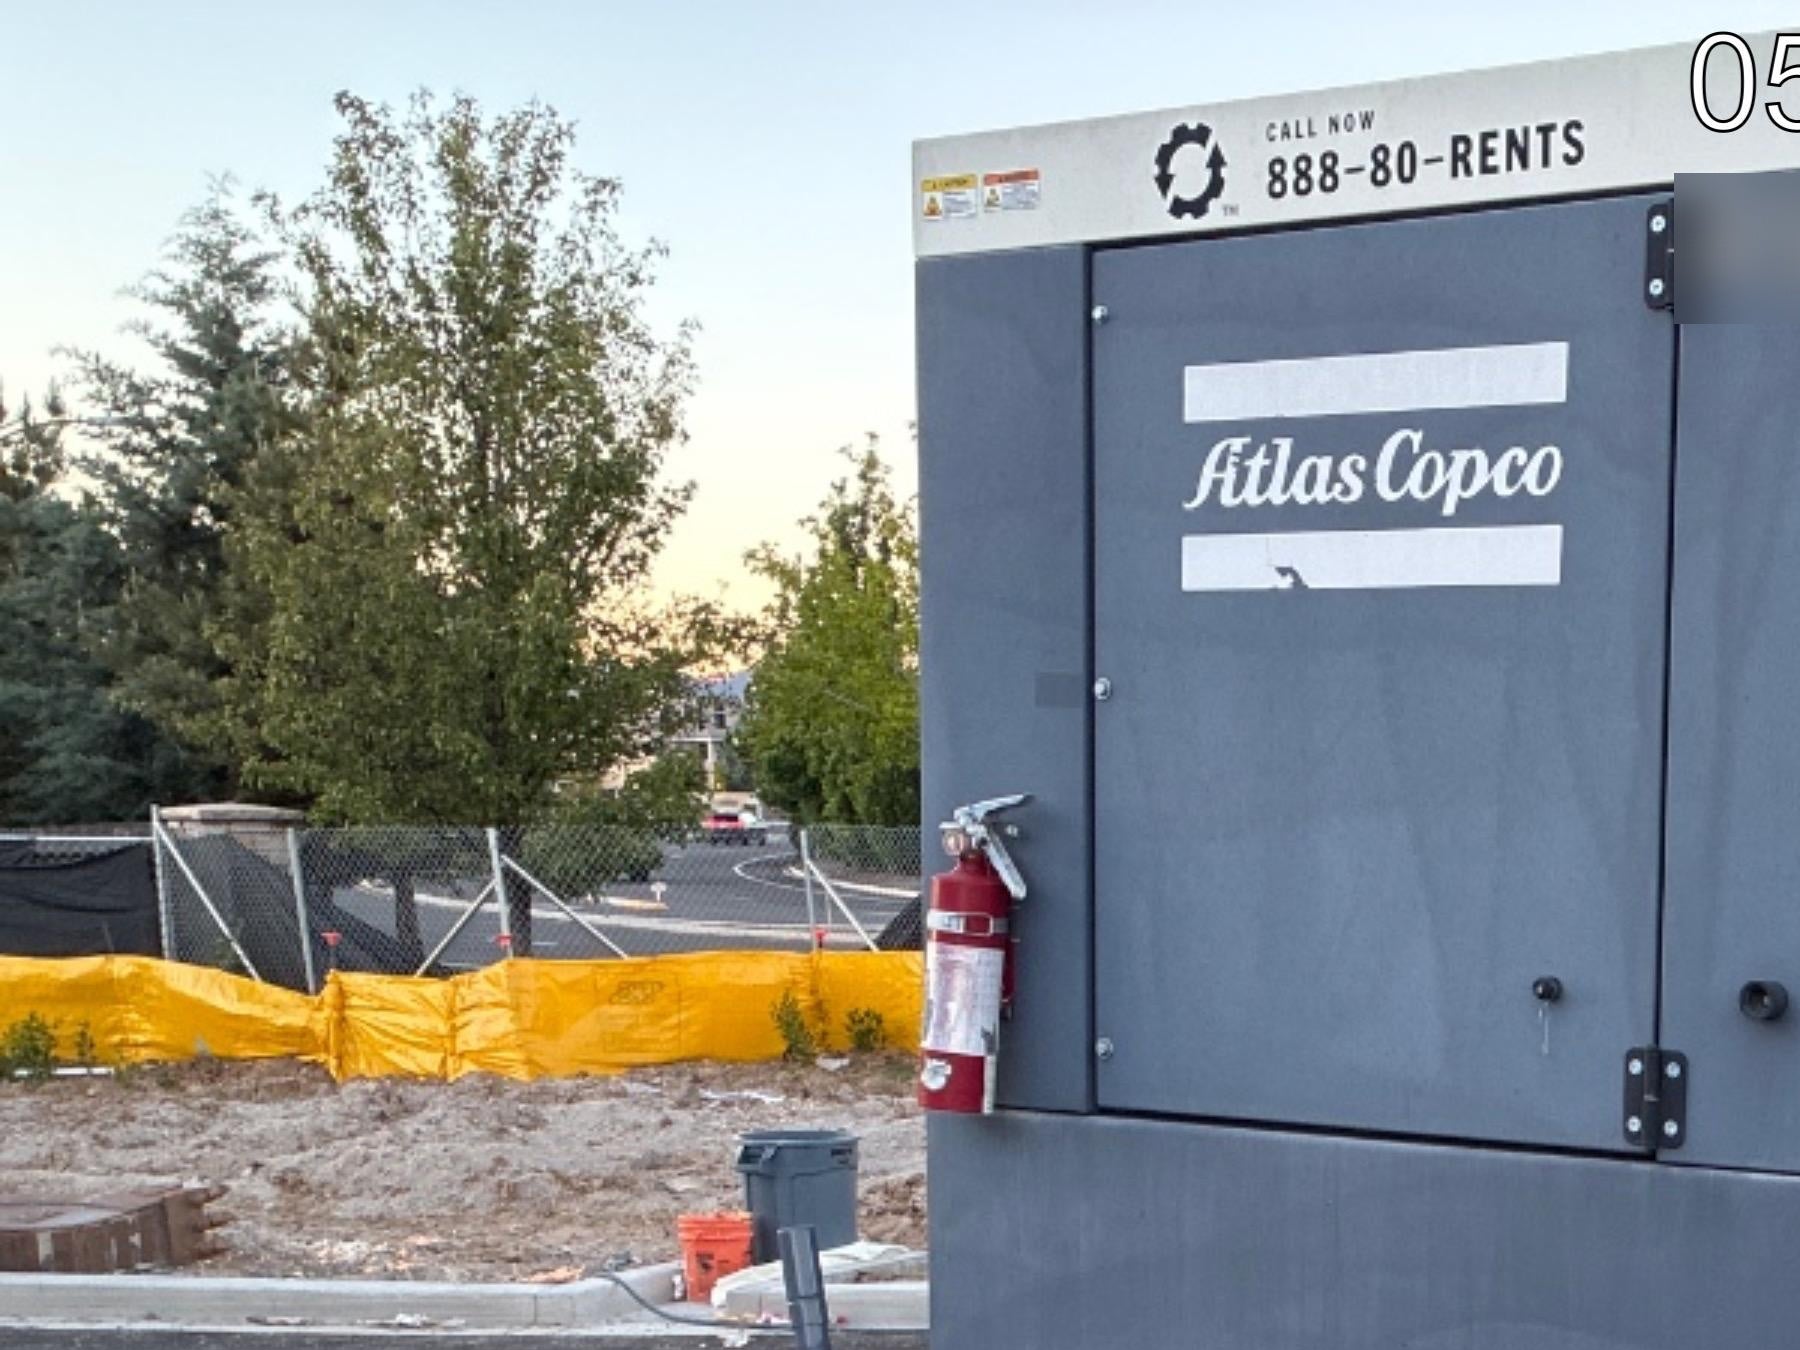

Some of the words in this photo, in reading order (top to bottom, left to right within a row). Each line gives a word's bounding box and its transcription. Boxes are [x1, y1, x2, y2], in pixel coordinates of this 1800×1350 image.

[1266, 117, 1317, 142] CALL
[1328, 110, 1375, 136] NOW
[1267, 119, 1585, 199] 888-80-RENTS
[1183, 435, 1366, 511] Atlas
[1375, 428, 1564, 517] Copco
